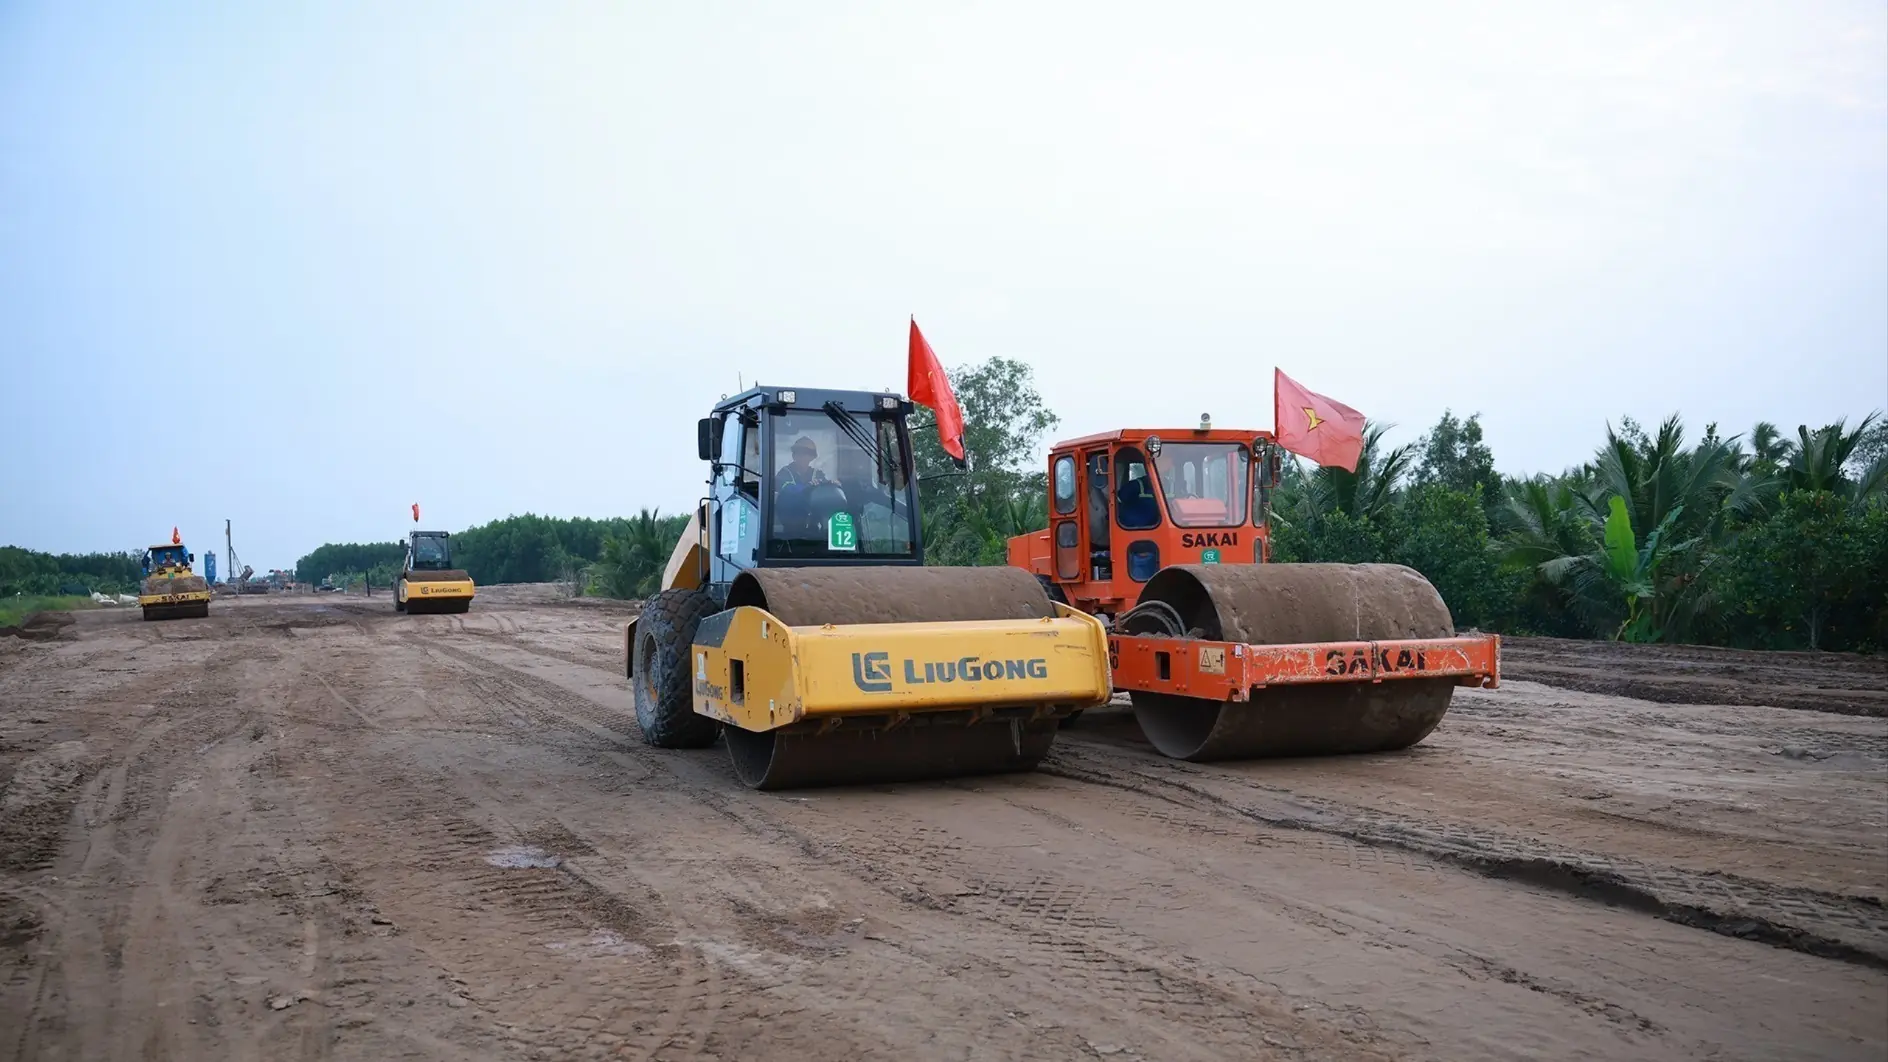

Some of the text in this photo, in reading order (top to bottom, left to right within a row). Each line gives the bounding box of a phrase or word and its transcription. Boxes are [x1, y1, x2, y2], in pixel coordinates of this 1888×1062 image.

[836, 530, 852, 545] 12
[1182, 532, 1238, 548] SAKAI
[1326, 649, 1425, 675] SAKAI
